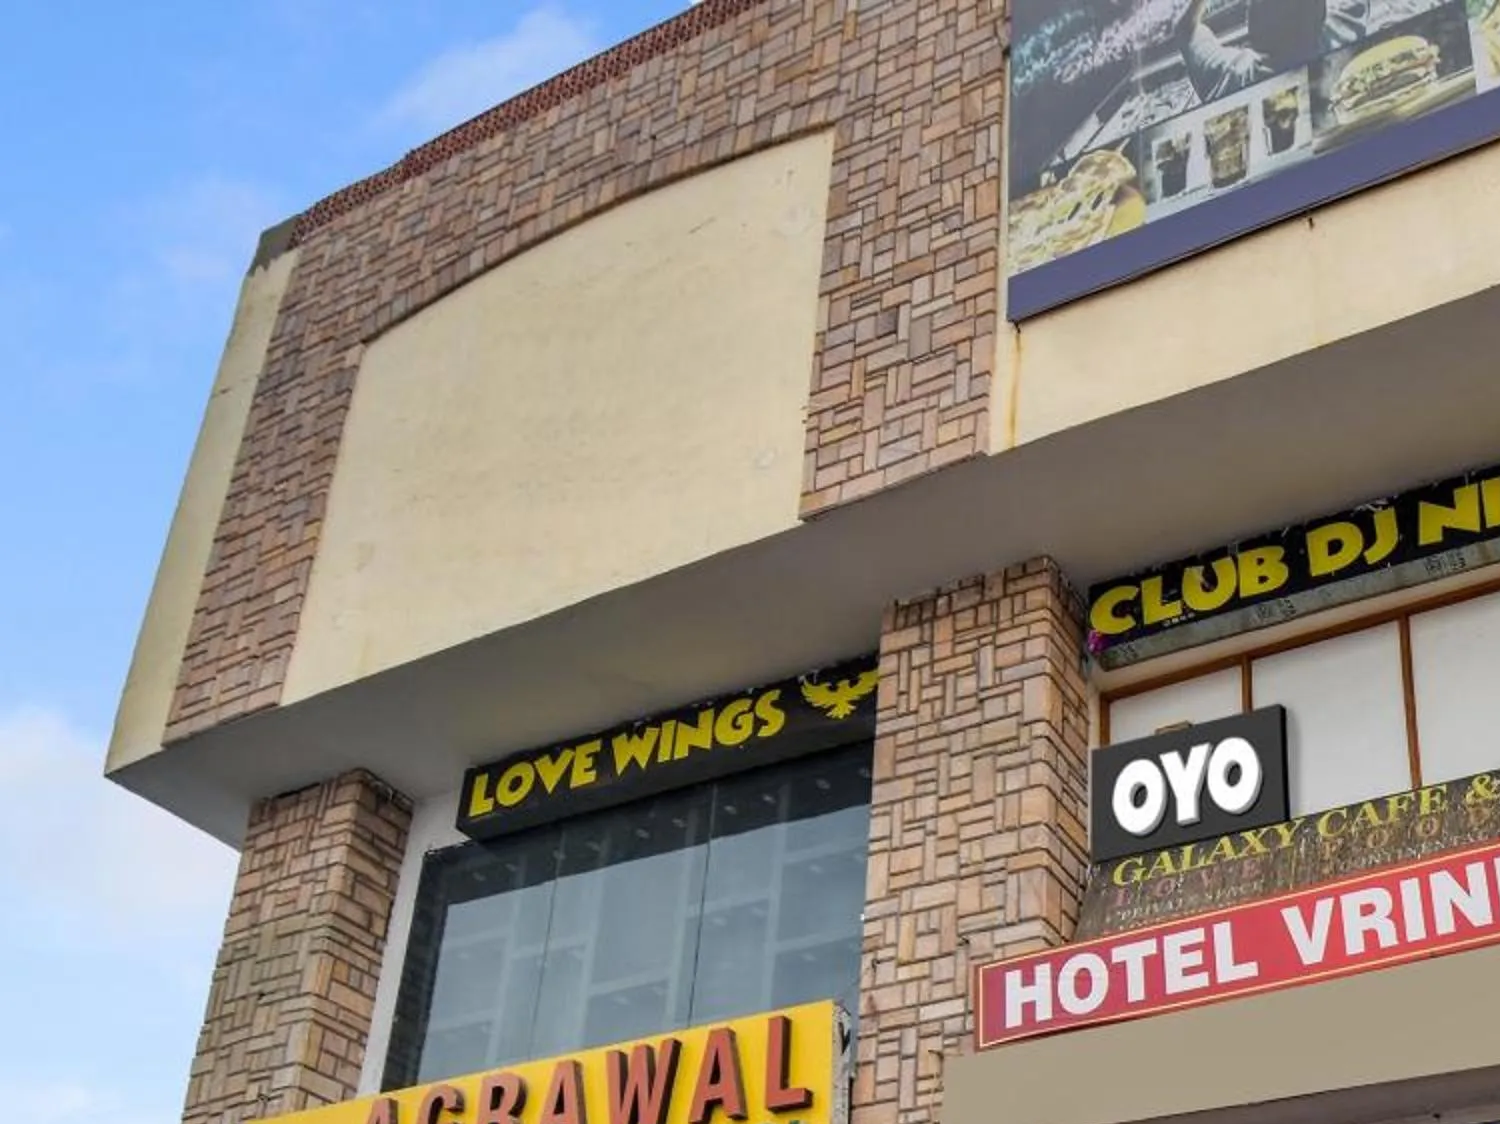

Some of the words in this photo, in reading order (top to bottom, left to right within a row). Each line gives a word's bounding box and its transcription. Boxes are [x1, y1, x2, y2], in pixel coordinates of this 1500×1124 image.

[1089, 546, 1289, 635] CLUB
[1305, 503, 1400, 579] DJ
[468, 740, 600, 817] LOVE
[612, 689, 785, 776] WINGS
[1111, 736, 1263, 837] OYO
[1112, 818, 1306, 887] GALAXY
[1316, 785, 1448, 837] CAFE
[1004, 925, 1259, 1028] HOTEL
